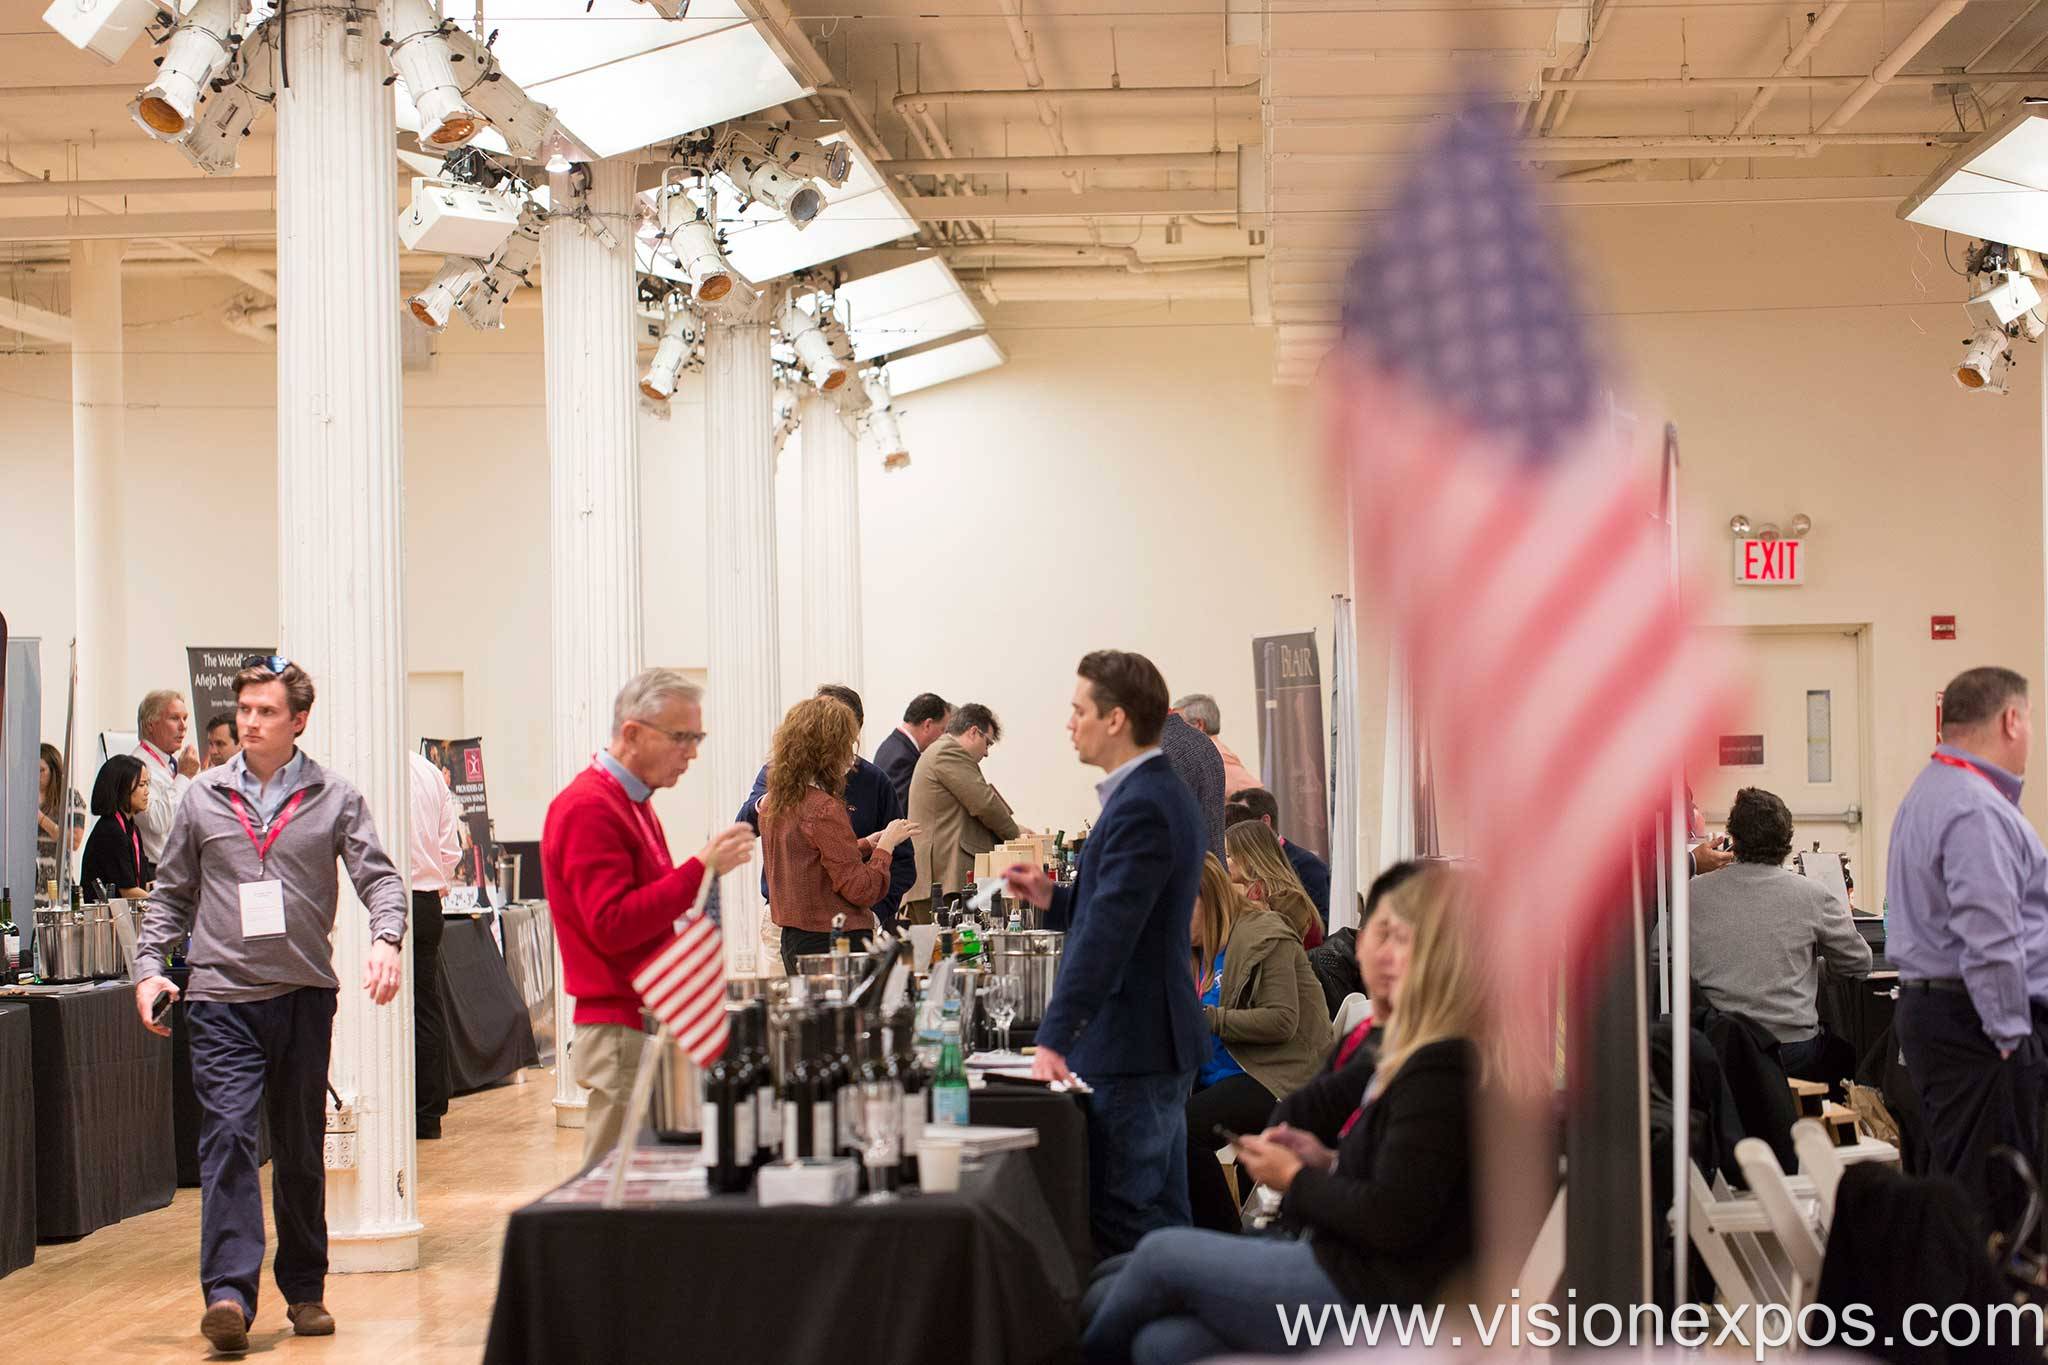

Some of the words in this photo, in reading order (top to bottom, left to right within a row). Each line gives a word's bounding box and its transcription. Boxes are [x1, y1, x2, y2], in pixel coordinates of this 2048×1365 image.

[1745, 541, 1799, 579] EXIT
[203, 653, 217, 667] The
[217, 653, 247, 667] World'
